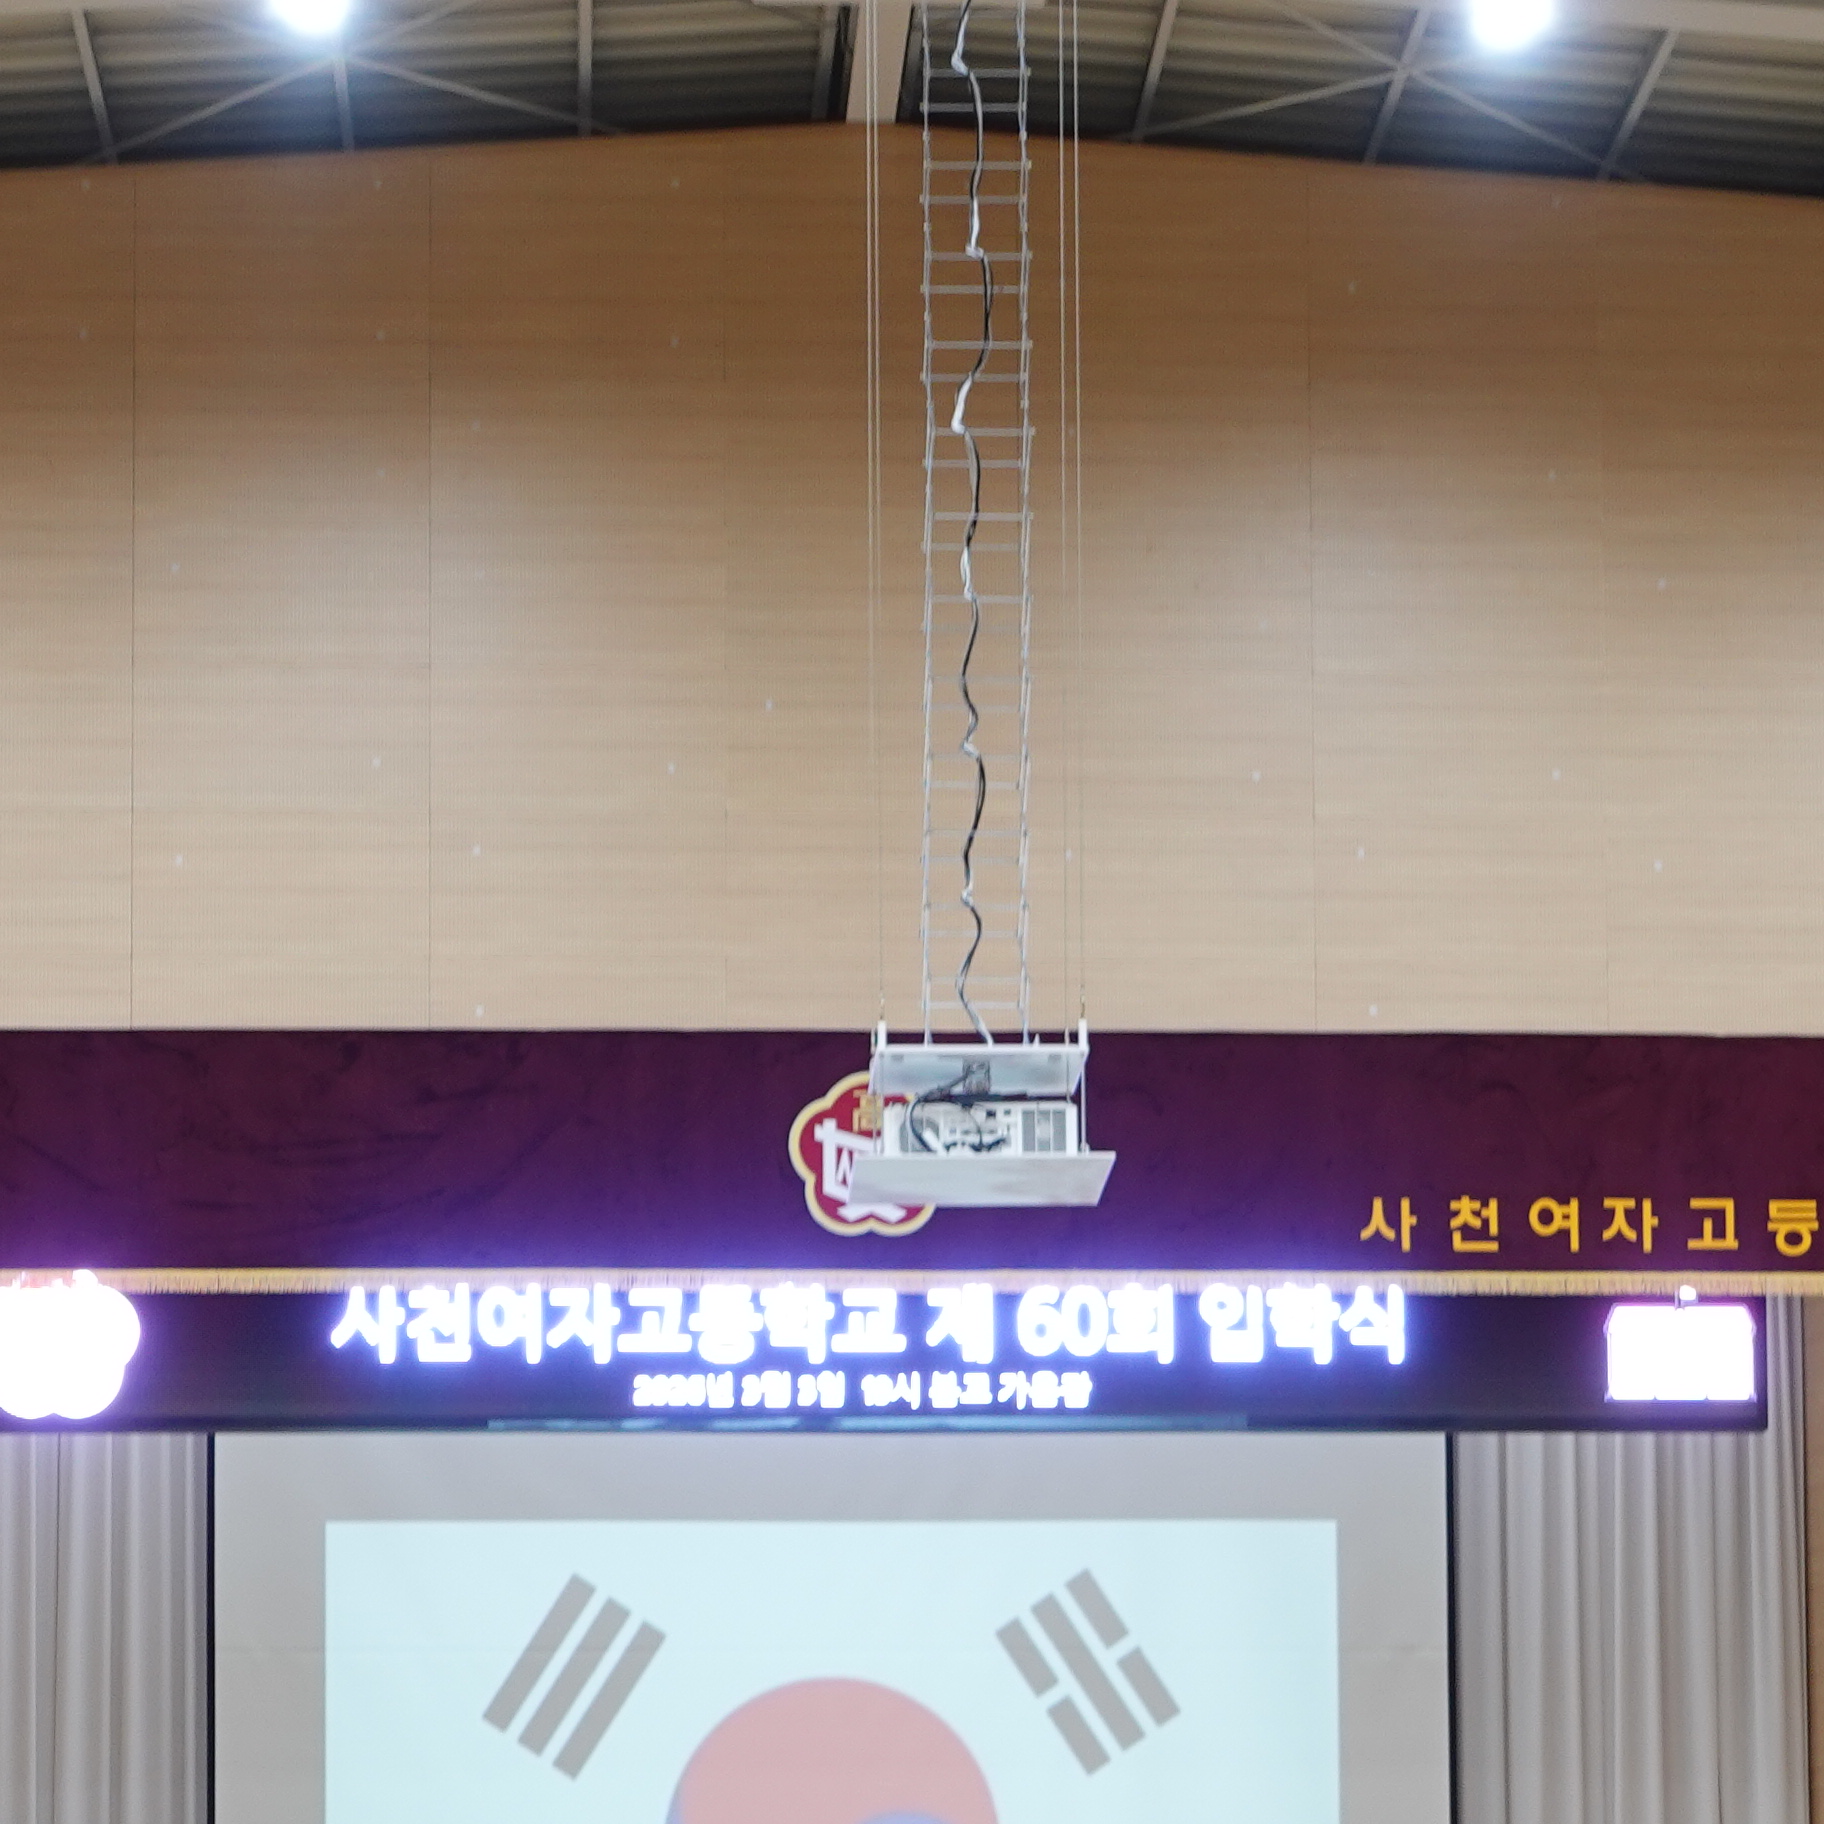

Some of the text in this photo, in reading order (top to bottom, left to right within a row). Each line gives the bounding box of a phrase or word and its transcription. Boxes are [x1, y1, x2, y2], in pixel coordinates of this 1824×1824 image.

[330, 1282, 1406, 1365] 사천여자고등학교 제 60회 입학식
